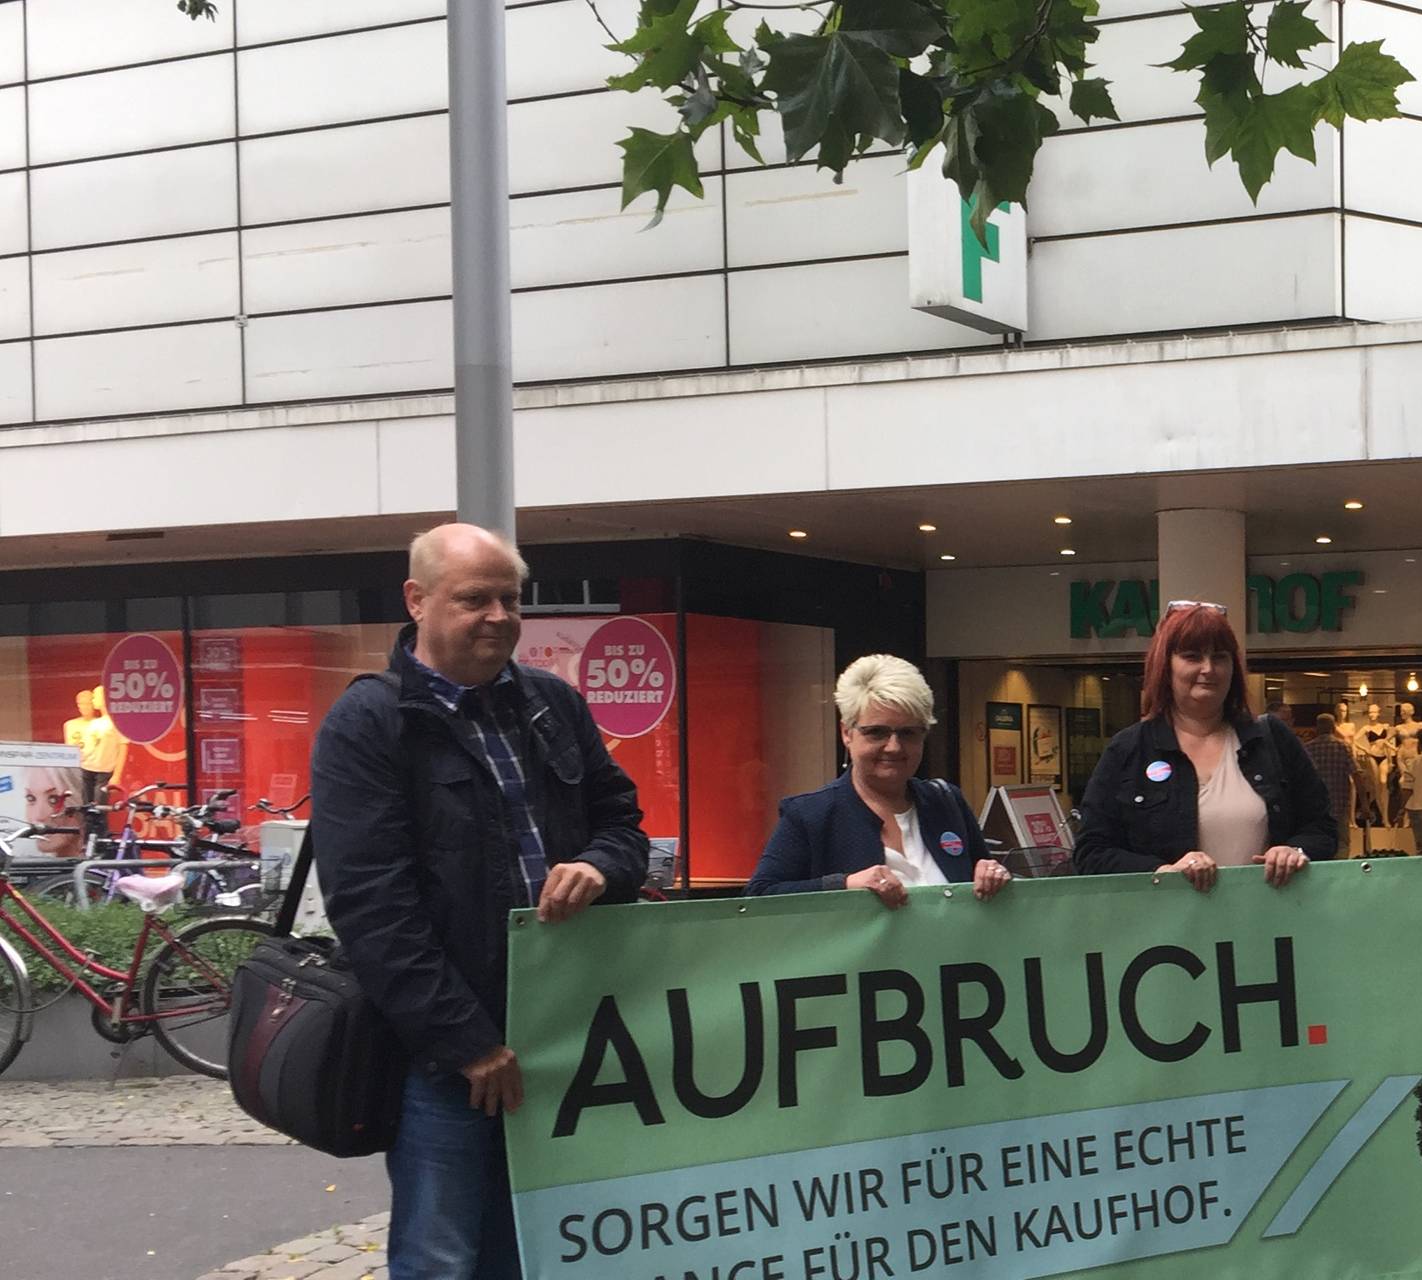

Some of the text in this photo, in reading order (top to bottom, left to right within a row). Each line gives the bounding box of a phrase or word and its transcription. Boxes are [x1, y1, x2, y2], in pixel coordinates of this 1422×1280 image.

[1070, 571, 1364, 639] KAHOF
[603, 645, 645, 656] BIS ZU
[109, 671, 175, 699] 50%
[586, 658, 665, 688] 50%
[109, 701, 174, 713] REDUZIERT
[586, 690, 664, 704] REDUZIERT
[552, 936, 1327, 1138] AUFBRUCH.
[559, 1115, 1247, 1263] SORGEN WIR FÜR EINE ECHTE
[803, 1231, 895, 1280] FÜR
[907, 1216, 997, 1272] DEN
[1014, 1180, 1231, 1251] KAUFHOF.
